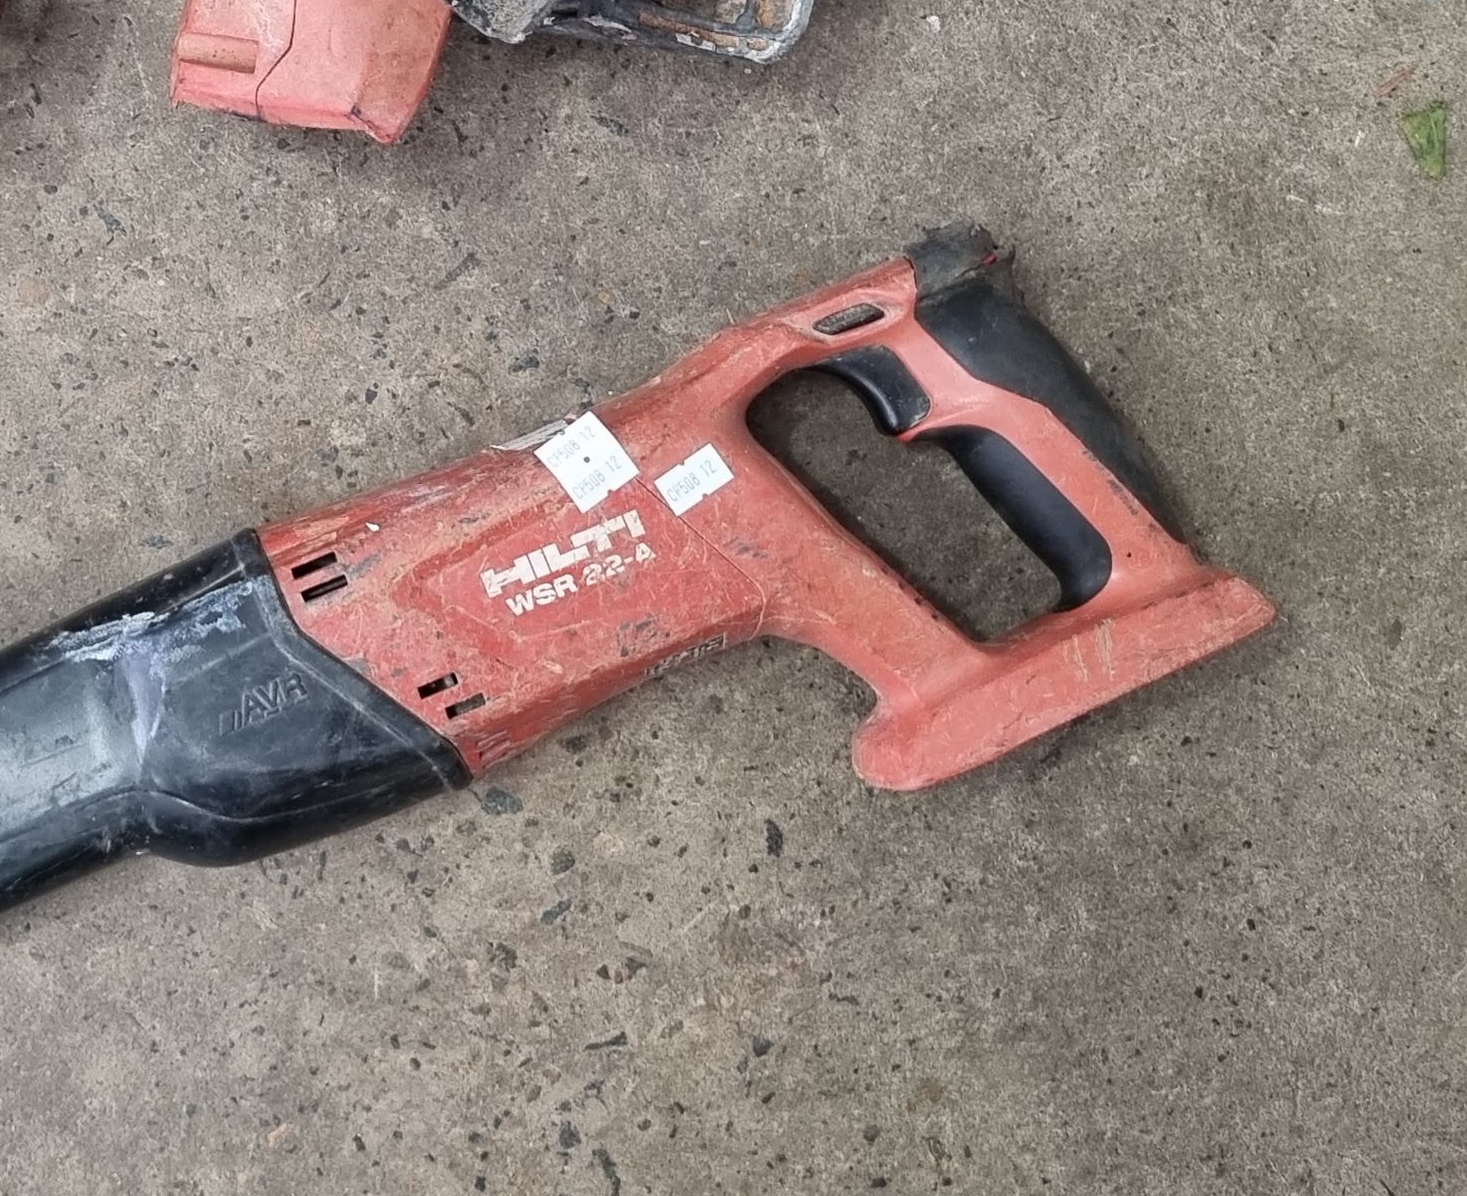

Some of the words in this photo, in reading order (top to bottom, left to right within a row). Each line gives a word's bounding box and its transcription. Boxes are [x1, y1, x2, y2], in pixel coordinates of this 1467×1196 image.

[546, 438, 582, 468] CP508
[580, 425, 597, 442] 12
[571, 468, 607, 501] CP508
[605, 455, 623, 473] 12
[665, 472, 702, 503] CP508
[699, 459, 718, 477] 12
[480, 509, 646, 598] HILTI
[505, 573, 579, 616] WSR
[583, 541, 657, 587] 22-A
